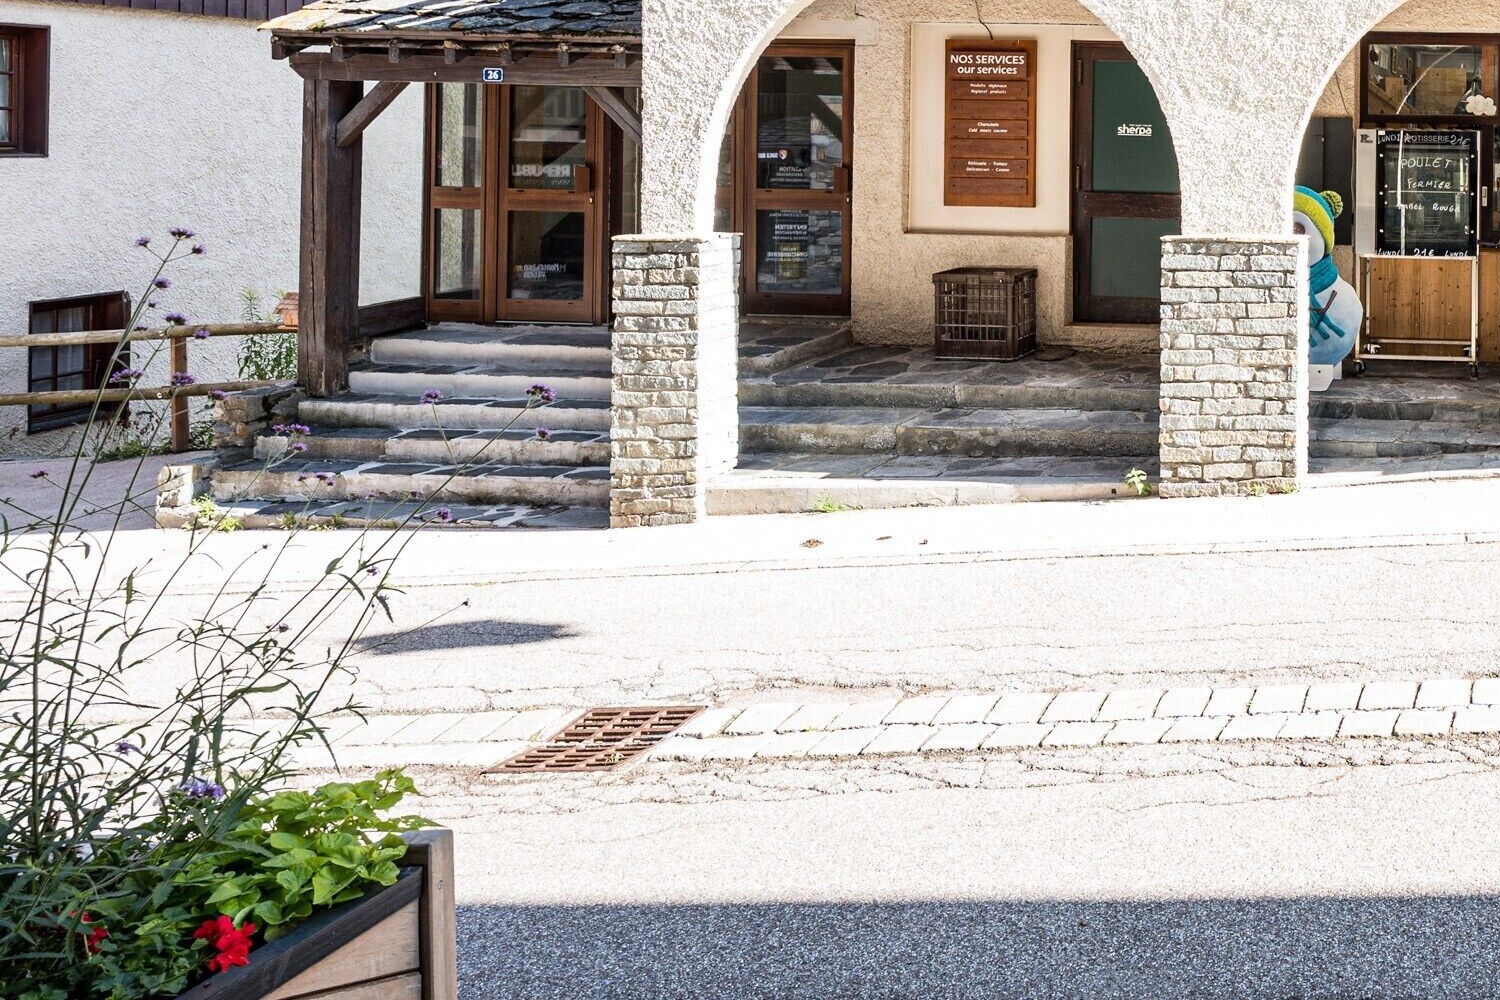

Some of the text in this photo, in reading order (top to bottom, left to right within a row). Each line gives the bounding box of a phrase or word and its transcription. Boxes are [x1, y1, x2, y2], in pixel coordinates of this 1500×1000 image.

[950, 54, 1024, 65] NOS SERVICES
[487, 70, 499, 80] 26
[957, 65, 1018, 75] our services
[1117, 123, 1152, 136] sherpa
[1450, 134, 1470, 147] 21€
[1400, 156, 1453, 169] POULET
[1413, 247, 1435, 257] 21€
